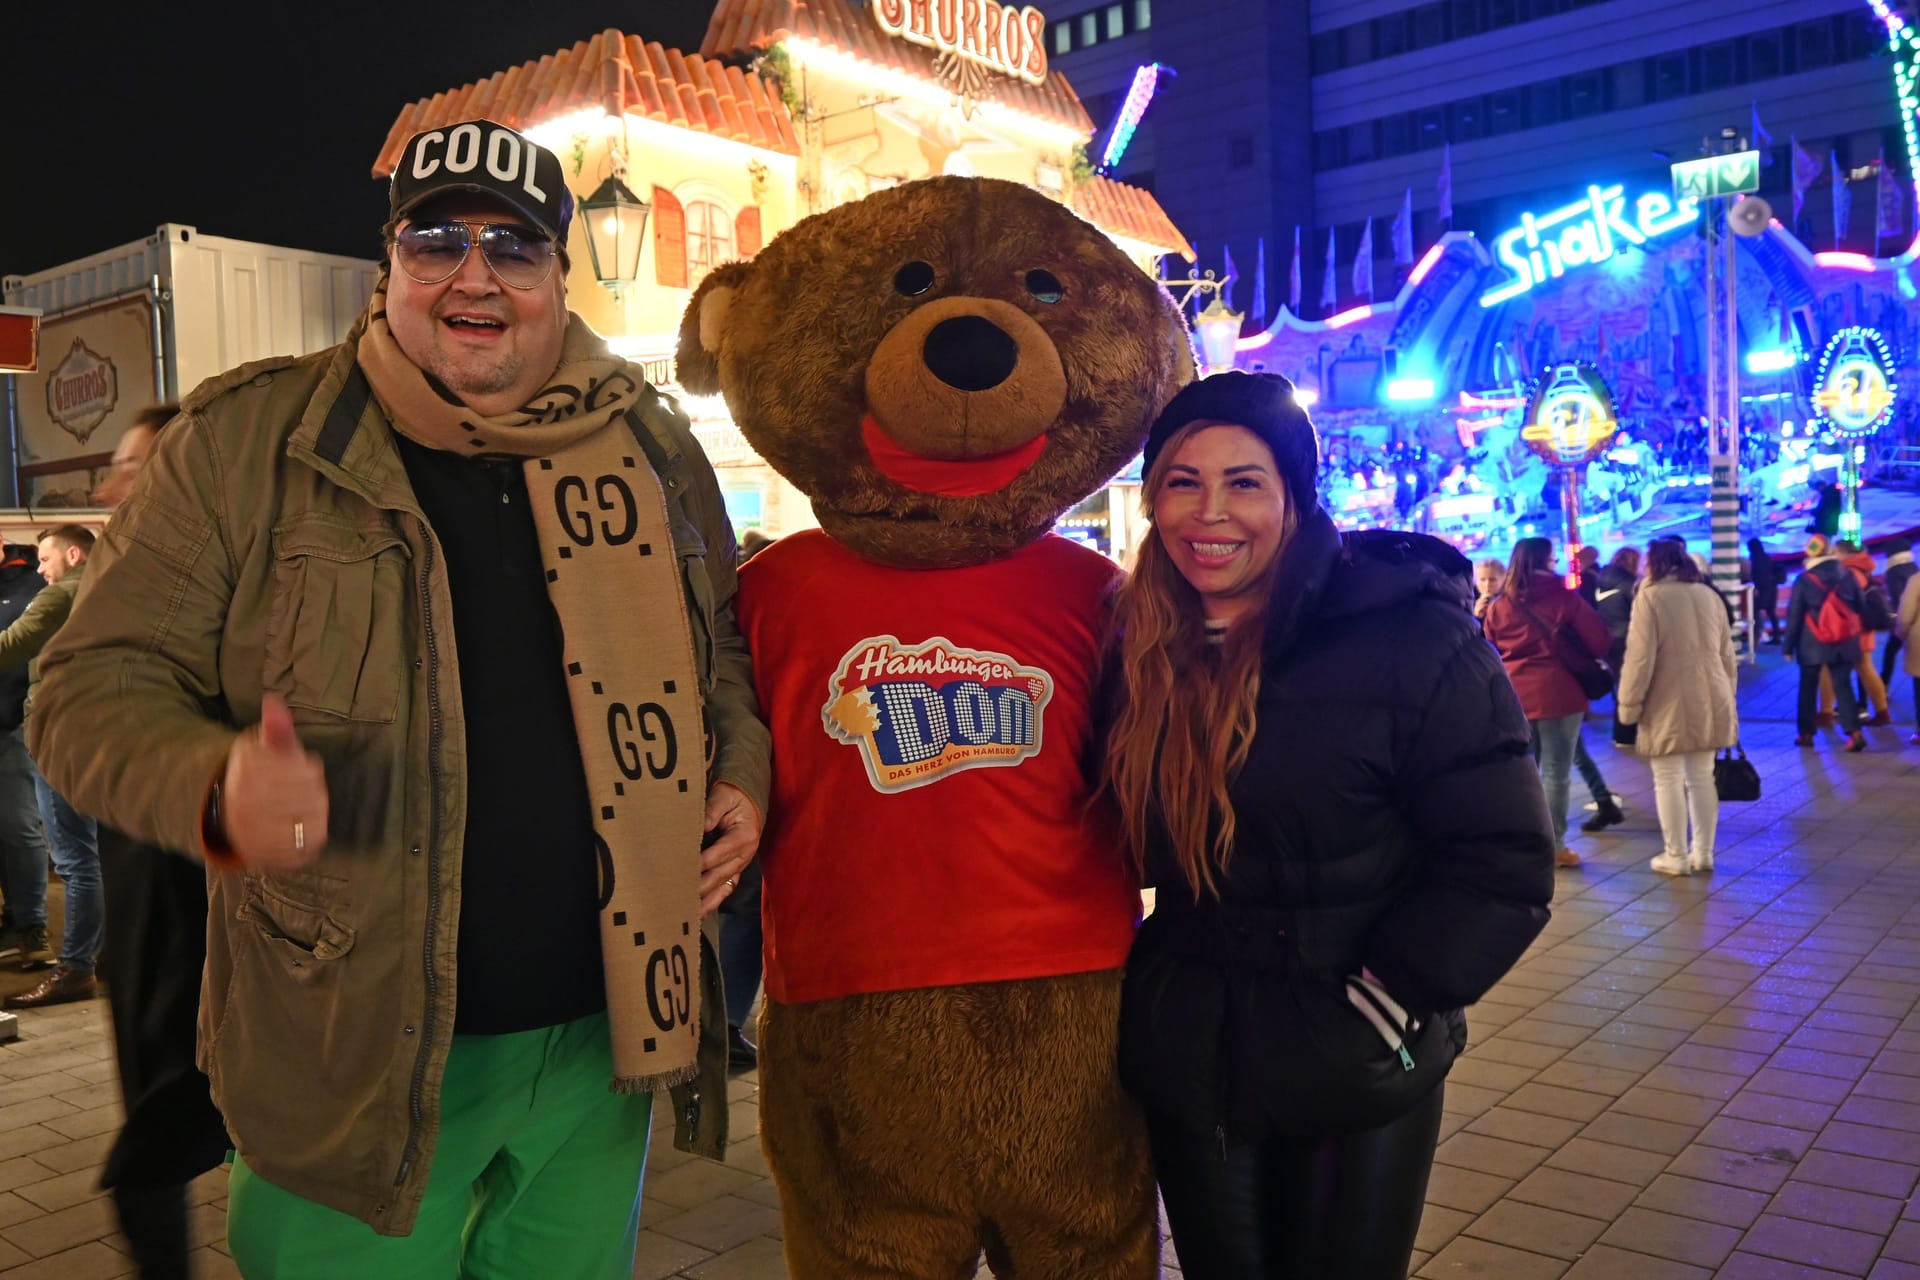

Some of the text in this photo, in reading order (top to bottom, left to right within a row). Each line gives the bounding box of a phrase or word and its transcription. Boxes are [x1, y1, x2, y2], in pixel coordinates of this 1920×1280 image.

[412, 123, 547, 204] COOL
[1479, 183, 1700, 308] Shaker
[55, 363, 107, 412] CHURROS
[856, 646, 1014, 682] Hamburger
[888, 747, 1016, 780] DAS HERZ VON HAMBURG
